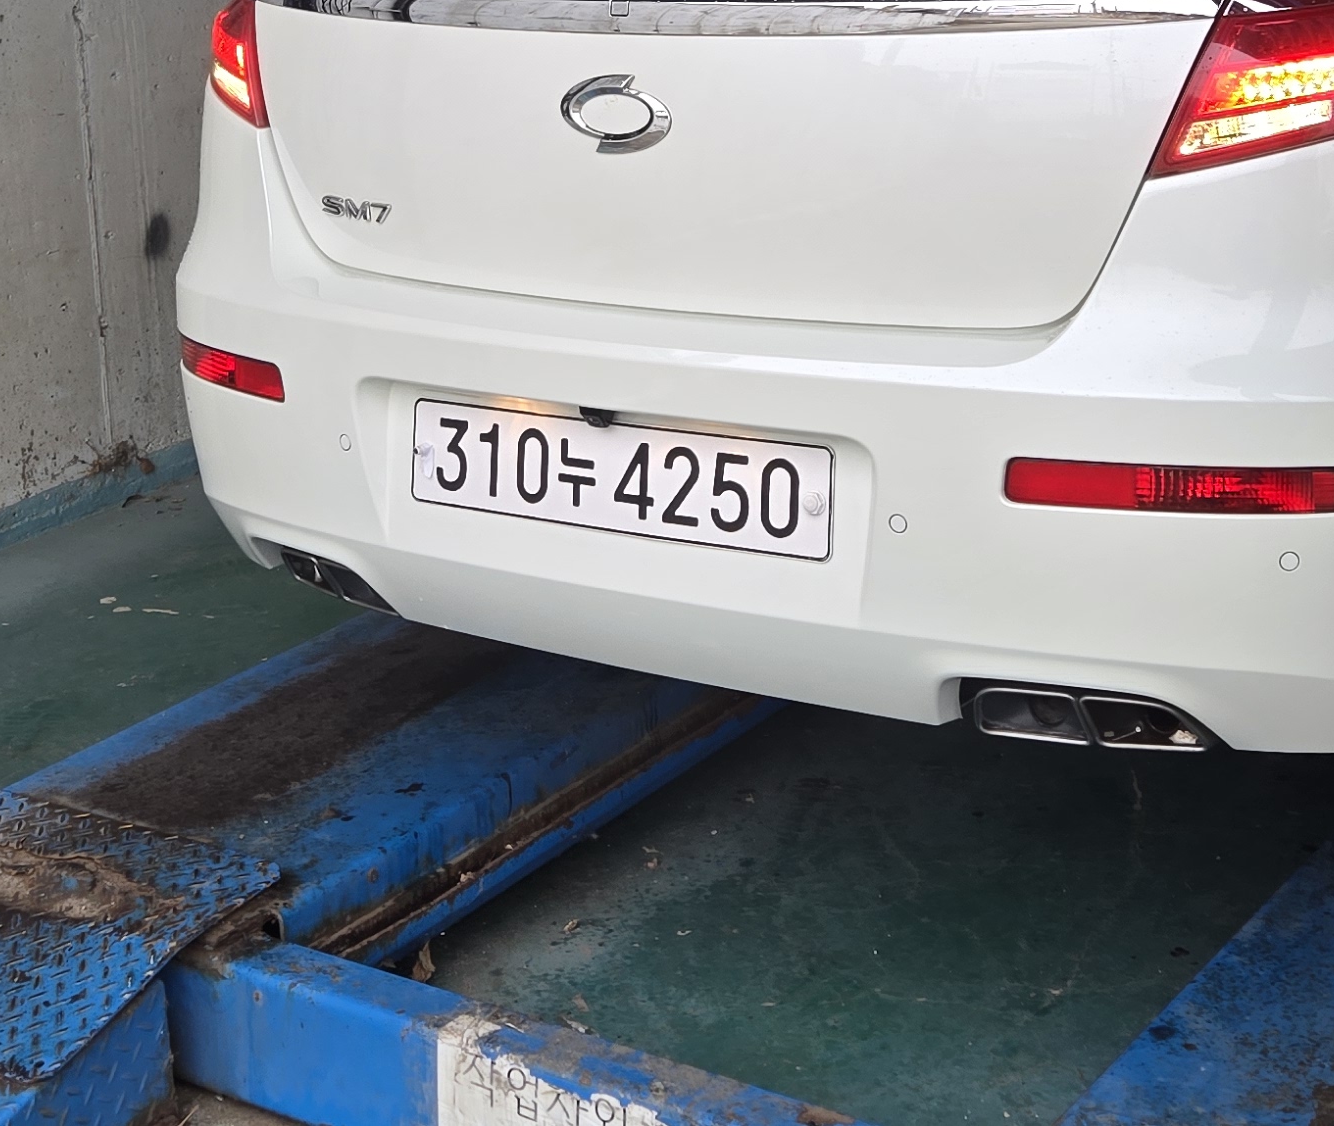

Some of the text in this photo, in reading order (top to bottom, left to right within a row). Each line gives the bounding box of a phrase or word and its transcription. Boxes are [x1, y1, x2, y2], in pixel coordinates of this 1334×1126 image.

[321, 194, 392, 224] SM7
[435, 417, 801, 539] 310누 4250
